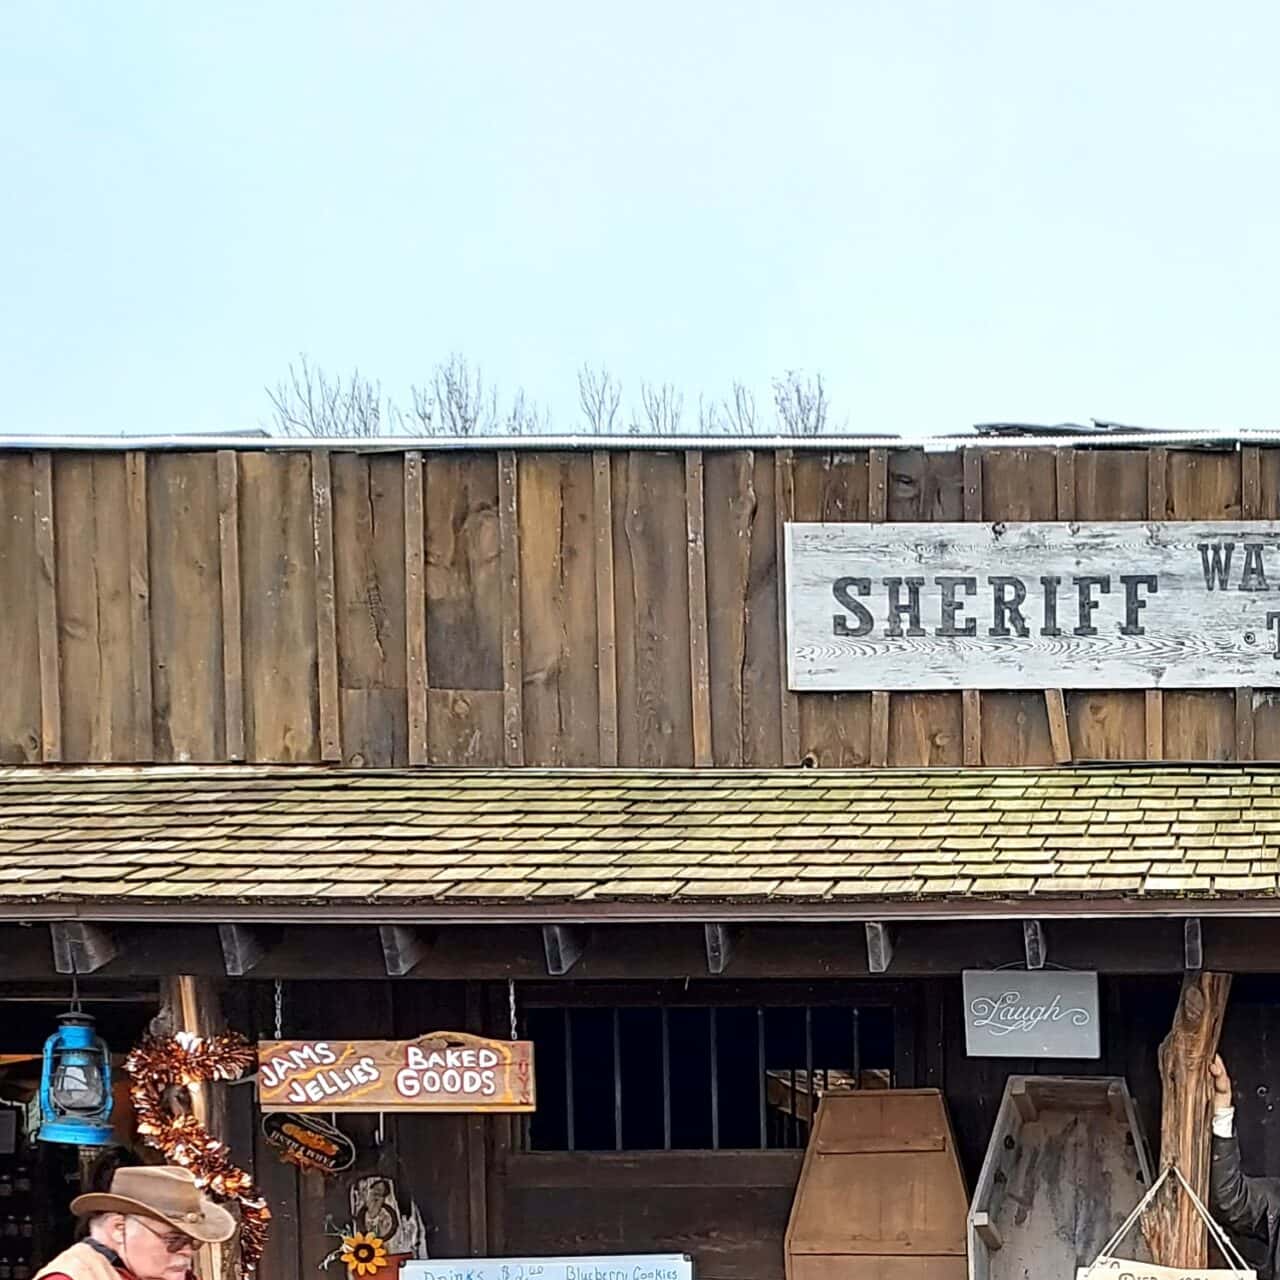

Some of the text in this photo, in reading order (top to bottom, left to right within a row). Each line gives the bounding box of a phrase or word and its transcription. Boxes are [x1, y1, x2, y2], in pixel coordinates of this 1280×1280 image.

[831, 573, 1159, 638] SHERIFF
[971, 992, 1089, 1035] Laugh
[261, 1042, 336, 1087] JAMS
[406, 1046, 498, 1071] BAKED
[287, 1057, 379, 1104] JELLIES
[396, 1069, 496, 1096] GOODS
[632, 1265, 678, 1280] Cookies
